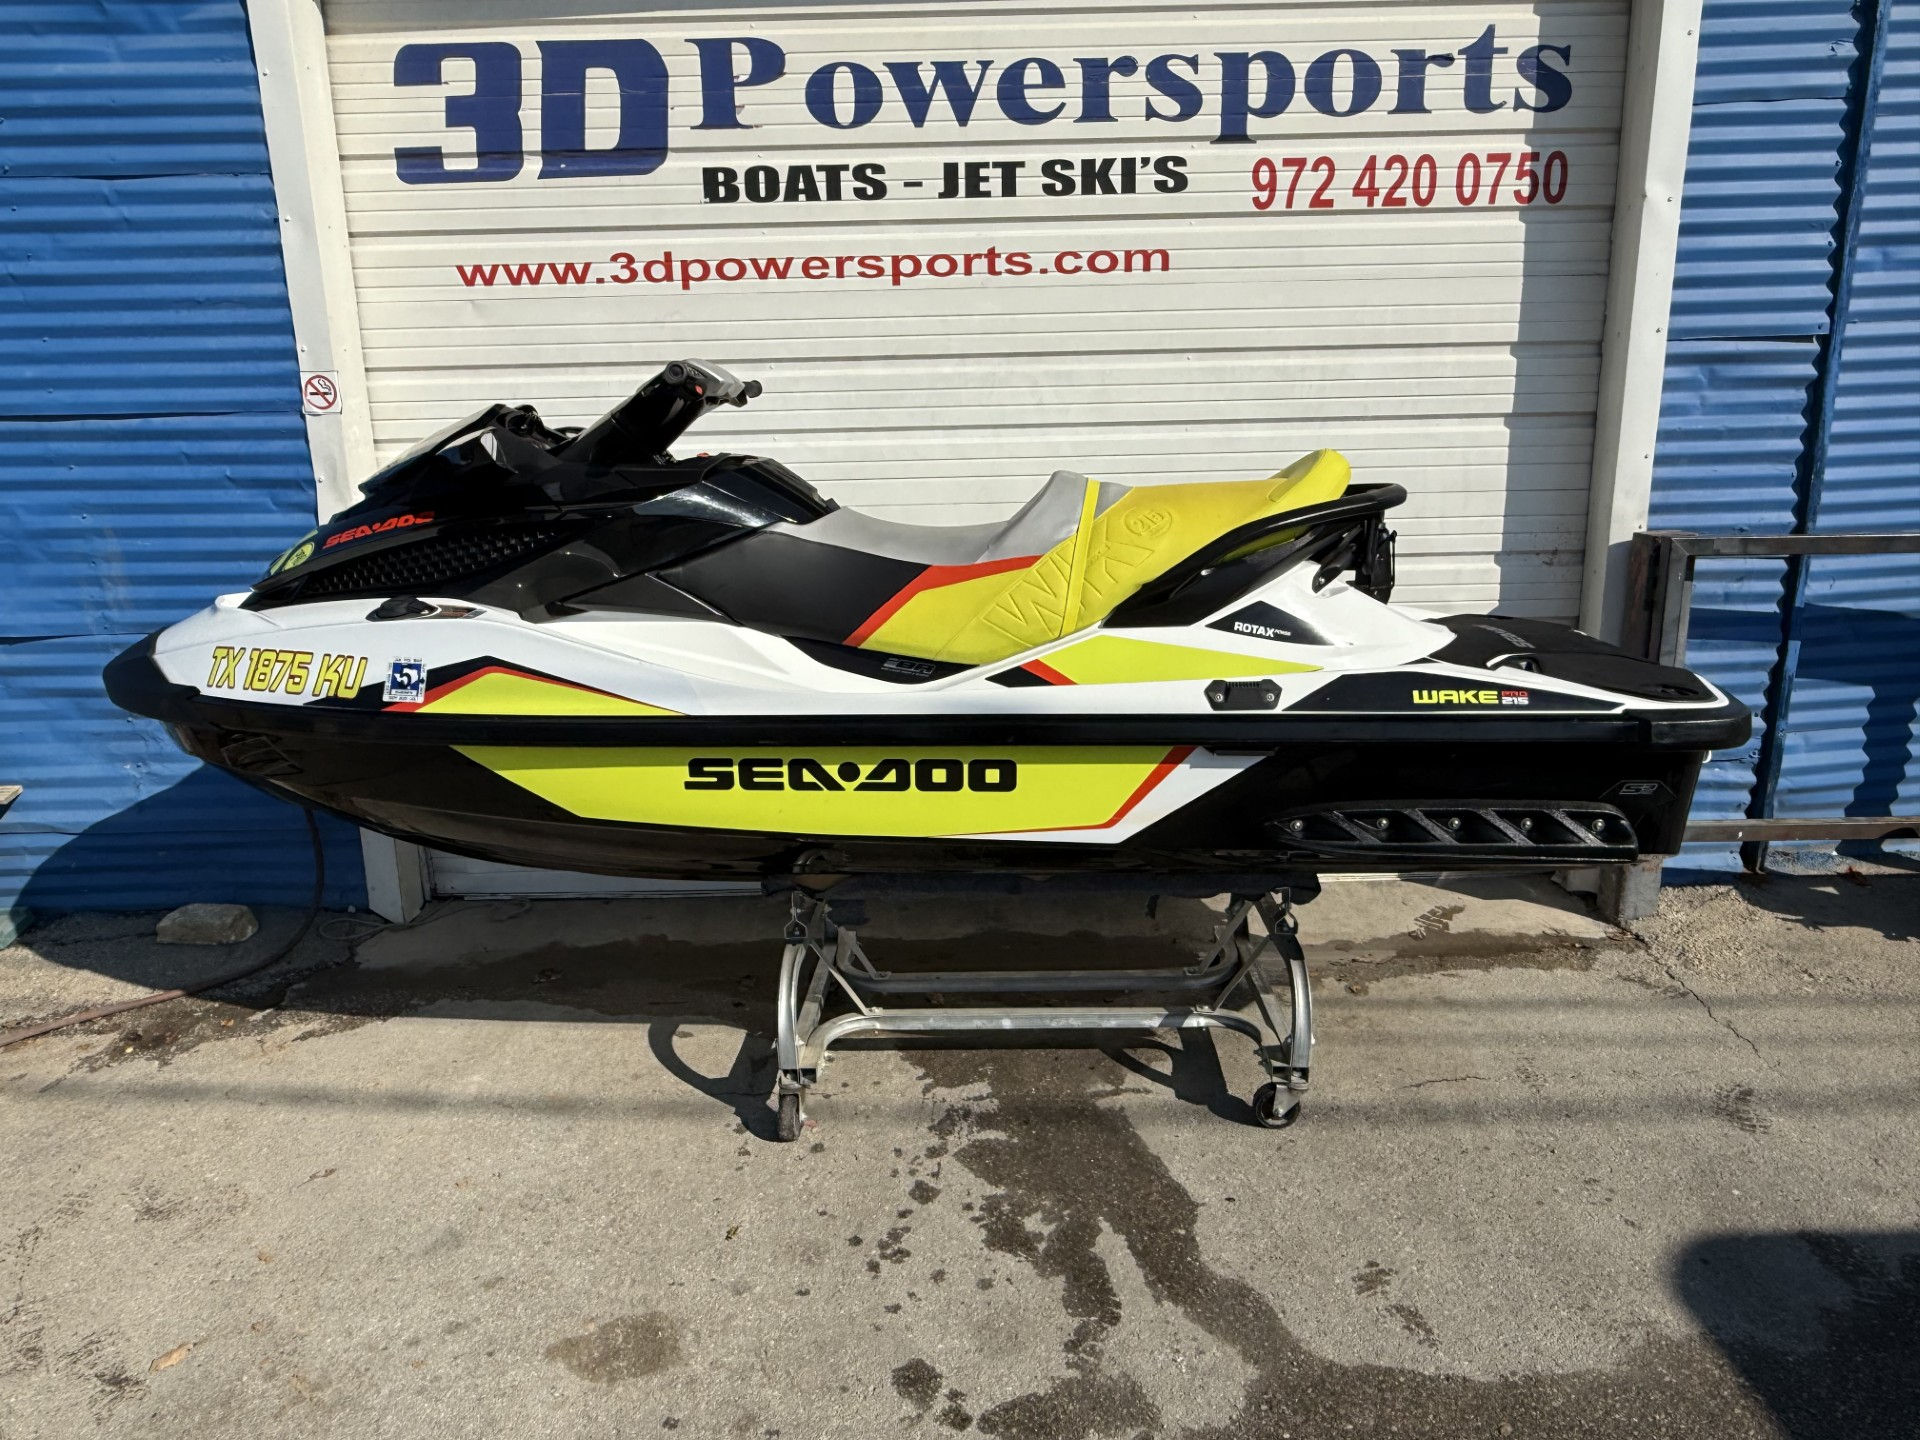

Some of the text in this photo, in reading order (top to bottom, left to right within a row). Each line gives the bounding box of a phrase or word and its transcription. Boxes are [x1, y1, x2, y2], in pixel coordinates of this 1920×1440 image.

[393, 24, 1573, 185] 3D Powersports
[701, 162, 888, 204] BOATS
[938, 161, 1026, 199] JET
[1041, 155, 1189, 196] SKI'S
[1252, 151, 1569, 211] 972 420 0750
[455, 246, 1171, 291] www.3dpowersports.com
[1233, 621, 1275, 638] ROTAX
[207, 646, 246, 689] TX
[243, 648, 314, 695] 1875
[312, 653, 368, 700] KU
[1412, 689, 1499, 704] WAKE
